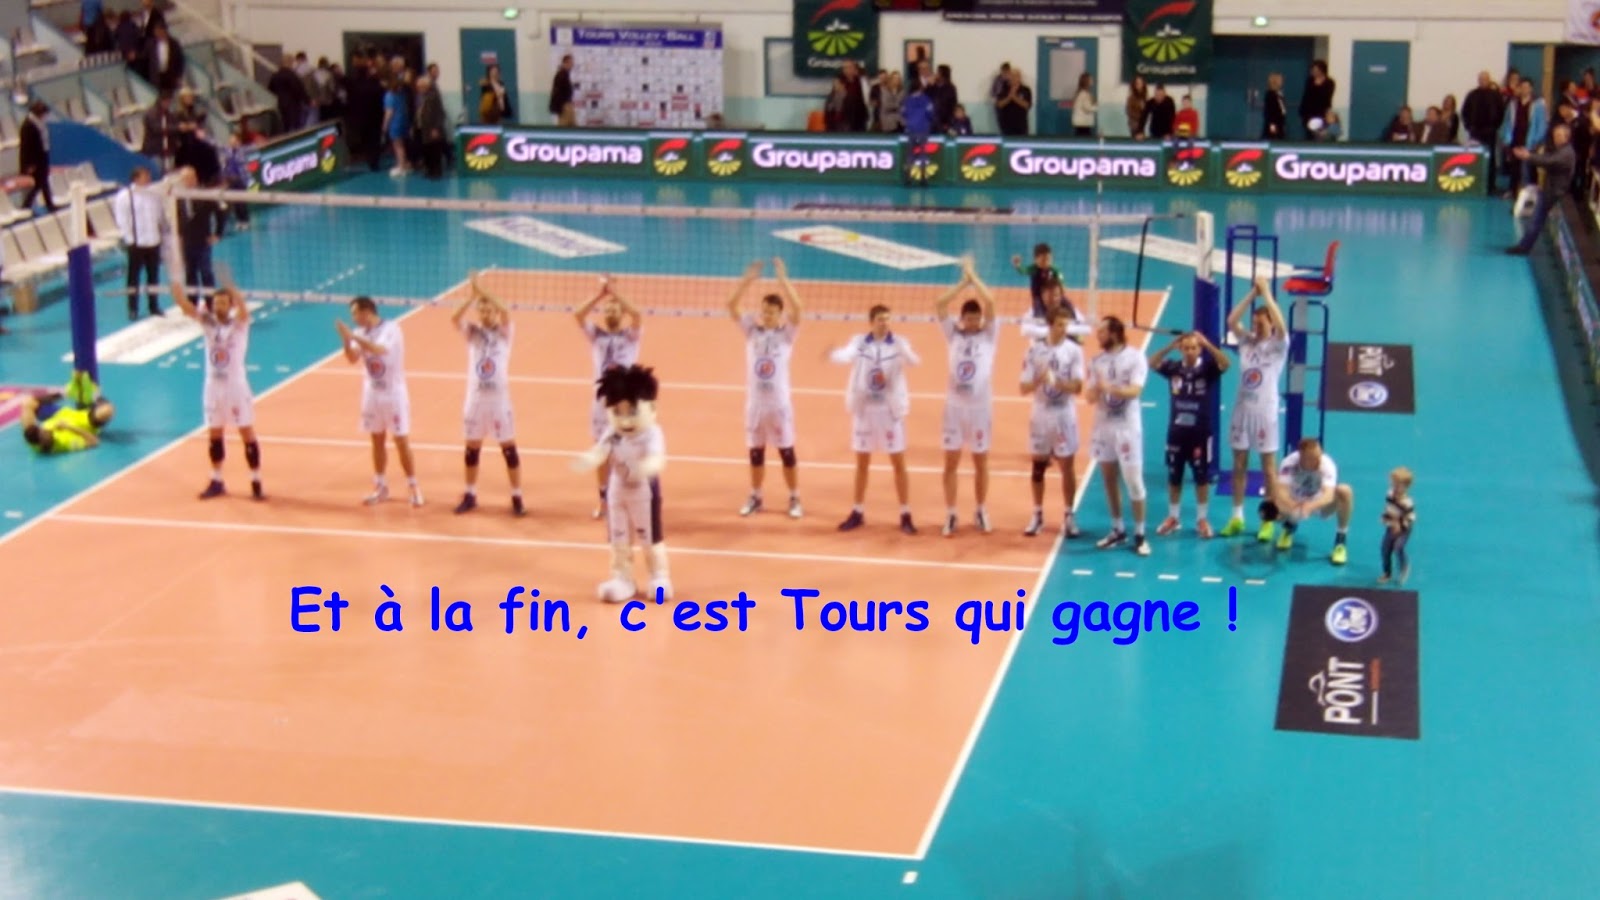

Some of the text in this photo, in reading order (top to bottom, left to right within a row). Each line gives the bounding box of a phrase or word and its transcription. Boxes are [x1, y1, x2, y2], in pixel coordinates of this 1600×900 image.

[1136, 63, 1197, 75] Groupama
[260, 151, 319, 184] Groupama
[506, 136, 643, 168] Groupama
[752, 141, 894, 173] Groupama
[1009, 148, 1156, 180] Groupama
[1275, 153, 1428, 185] Groupama
[1323, 655, 1366, 724] PONT
